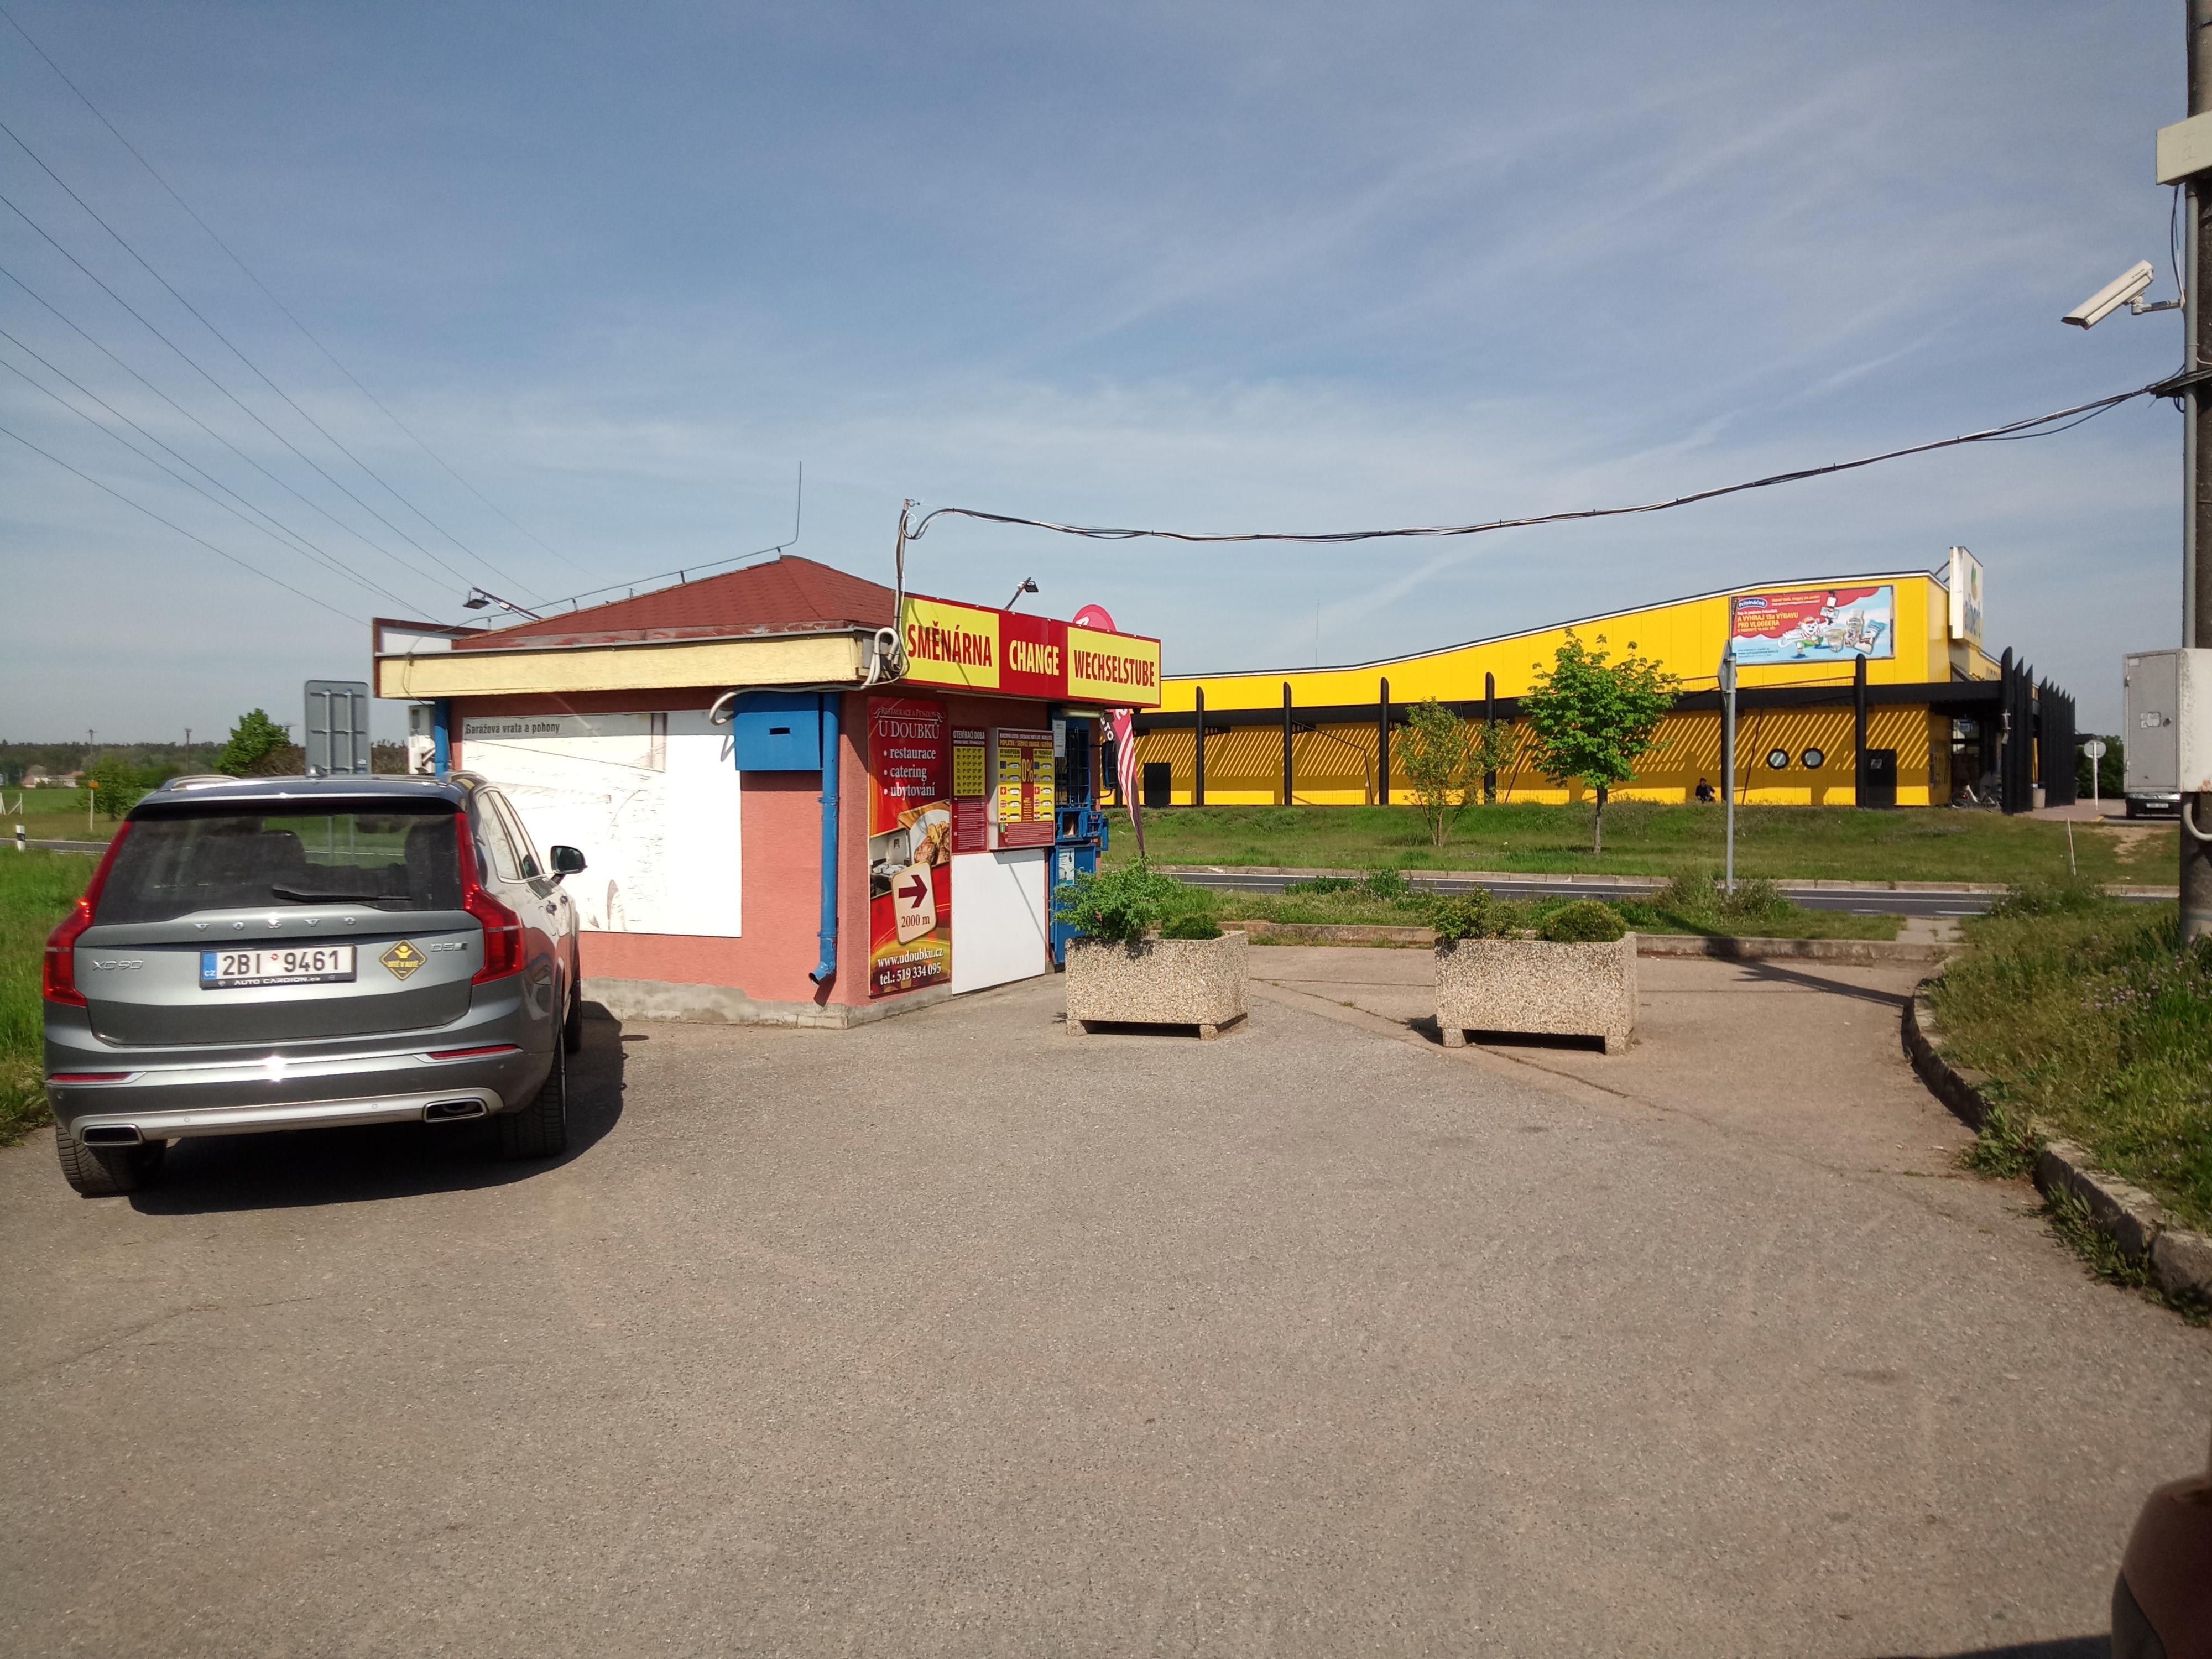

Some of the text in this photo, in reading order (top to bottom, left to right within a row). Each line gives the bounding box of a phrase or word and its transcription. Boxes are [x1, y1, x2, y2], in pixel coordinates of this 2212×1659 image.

[1739, 599, 1765, 608] Pribináček
[907, 620, 1155, 687] SMĚNÁRNA CHANGE WECHSELSTUBE
[503, 723, 523, 733] vrata
[524, 724, 530, 733] a
[532, 722, 560, 734] pohony
[878, 720, 940, 739] U DOUBKŮ
[974, 731, 985, 740] DOBA
[890, 748, 936, 760] restaurace
[890, 764, 927, 782] catering
[1022, 758, 1034, 783] 0%
[890, 782, 935, 801] ubytování
[901, 914, 930, 928] 2000 m
[222, 950, 339, 976] 2BI 9461
[878, 947, 943, 968] www.udoubku.cz
[263, 976, 321, 984] CARDION.cz
[880, 962, 942, 985] tel.: 519 334 095
